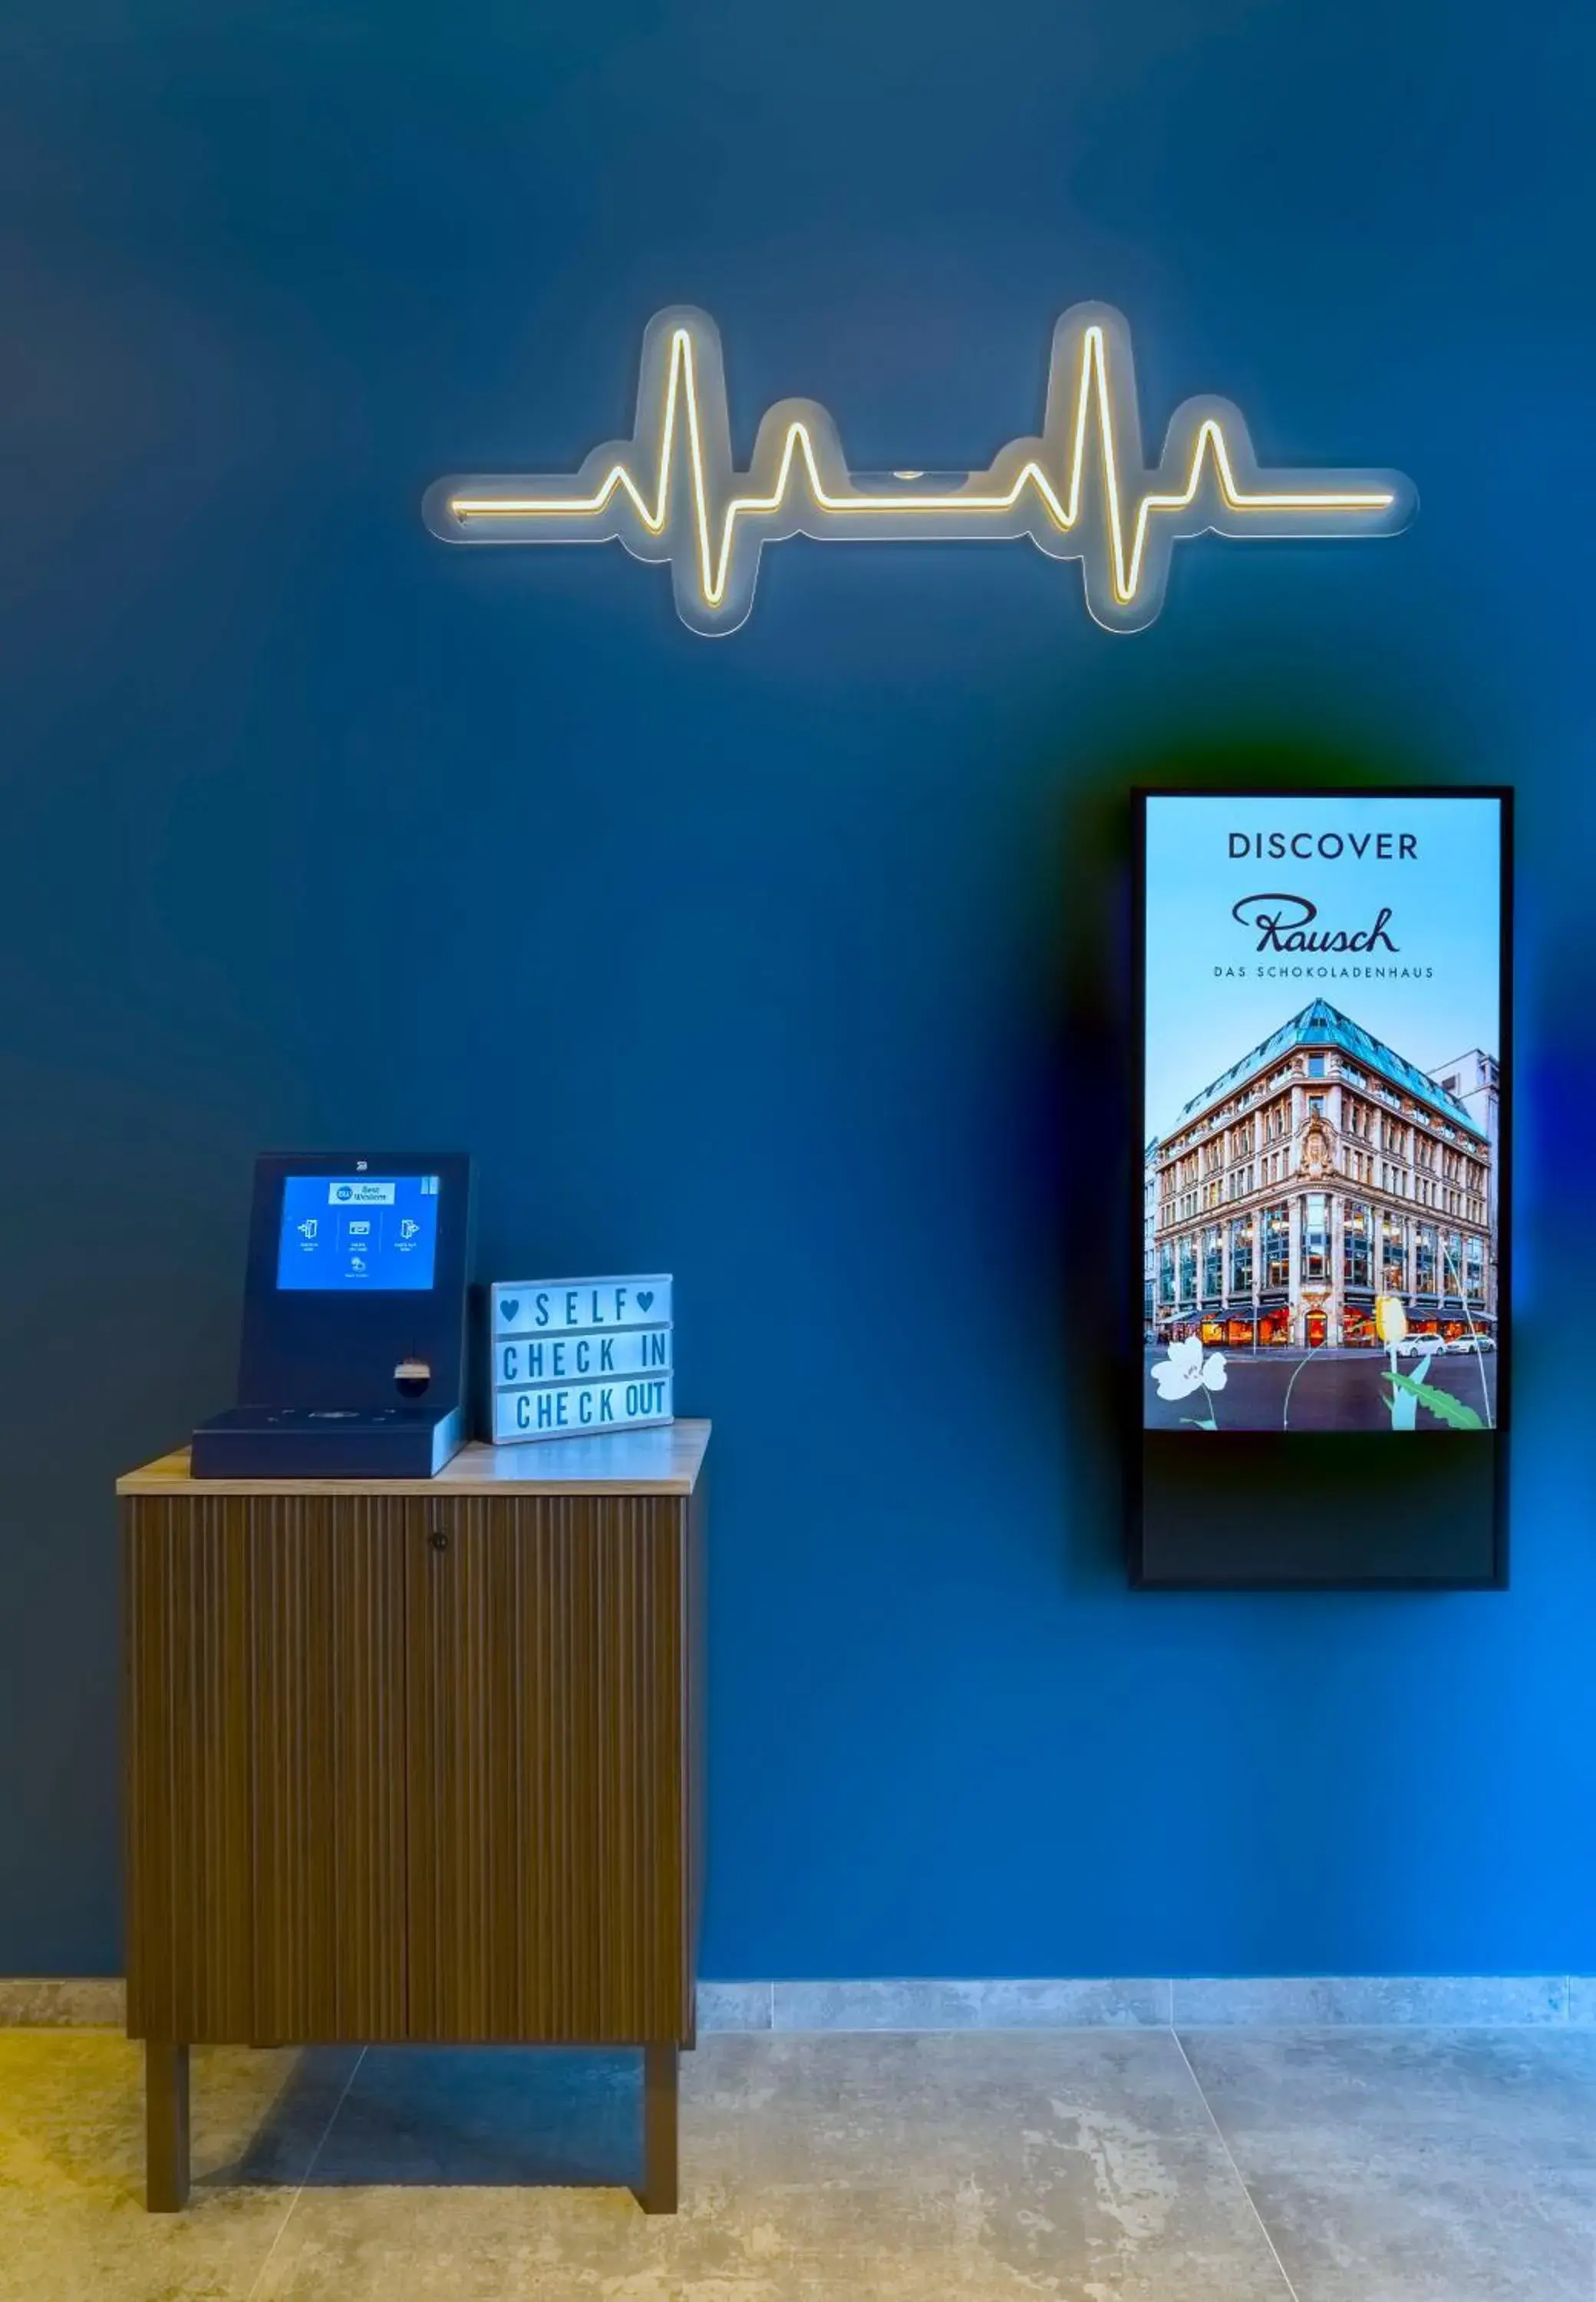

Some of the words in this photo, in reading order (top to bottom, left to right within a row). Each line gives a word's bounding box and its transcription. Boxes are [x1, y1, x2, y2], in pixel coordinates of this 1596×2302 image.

[1228, 833, 1418, 859] DISCOVER
[1232, 892, 1400, 952] Rausch
[1214, 966, 1245, 978] DAS
[1258, 966, 1433, 978] SCHOKOLADENHAUS
[536, 1288, 627, 1327] SELF
[503, 1338, 614, 1380] CHECK
[641, 1334, 665, 1367] IN
[516, 1389, 614, 1429] CHECK
[626, 1381, 665, 1416] OUT
